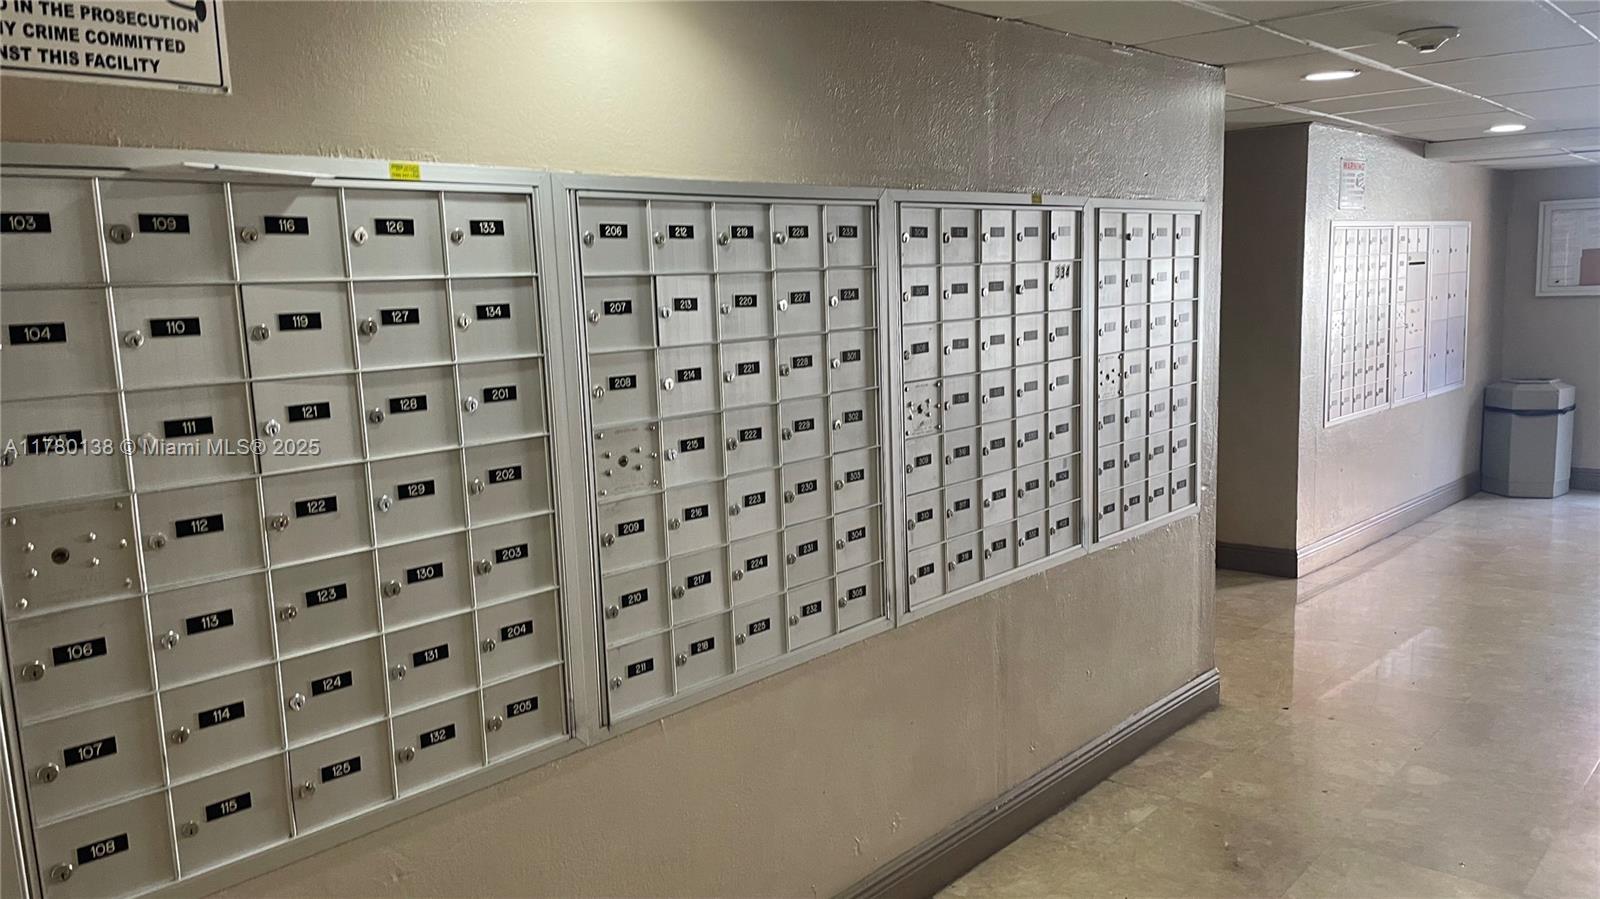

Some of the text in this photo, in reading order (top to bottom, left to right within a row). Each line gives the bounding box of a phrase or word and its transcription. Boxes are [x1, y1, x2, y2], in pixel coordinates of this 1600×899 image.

[14, 0, 34, 14] IN
[38, 1, 75, 19] THE
[80, 5, 199, 34] PROSECUTION
[23, 23, 80, 43] CRIME
[85, 30, 186, 54] COMMITTED
[37, 48, 80, 66] THIS
[84, 52, 160, 74] FACILITY
[9, 215, 36, 230] 103
[152, 217, 177, 231] 109
[279, 219, 295, 232] 116
[386, 221, 404, 233] 126
[479, 222, 496, 234] 133
[604, 225, 622, 236] 206
[674, 226, 688, 237] 212
[736, 227, 748, 237] 219
[791, 227, 805, 237] 226
[1055, 263, 1070, 279] 334
[738, 296, 753, 307] 220
[793, 293, 807, 303] 227
[843, 290, 856, 300] 234
[609, 302, 626, 313] 207
[680, 299, 692, 309] 213
[391, 310, 409, 323] 127
[485, 306, 502, 317] 134
[166, 320, 185, 334] 110
[292, 315, 309, 328] 119
[24, 326, 51, 341] 104
[796, 357, 809, 367] 228
[683, 370, 696, 381] 214
[743, 364, 755, 375] 221
[614, 377, 631, 388] 208
[492, 388, 509, 400] 201
[400, 398, 418, 410] 128
[302, 405, 318, 418] 121
[182, 421, 196, 434] 111
[797, 420, 811, 430] 229
[744, 430, 757, 440] 222
[686, 439, 699, 450] 215
[495, 468, 515, 481] 202
[408, 483, 425, 496] 129
[800, 482, 814, 493] 230
[748, 494, 761, 505] 223
[307, 500, 326, 513] 122
[690, 507, 703, 518] 216
[191, 519, 208, 533] 112
[623, 522, 640, 534] 209
[502, 547, 522, 560] 203
[803, 543, 814, 554] 231
[750, 558, 764, 569] 224
[416, 566, 434, 579] 130
[693, 574, 705, 586] 217
[317, 588, 337, 602] 123
[628, 592, 642, 605] 210
[806, 604, 818, 615] 232
[201, 614, 219, 629] 113
[753, 621, 766, 632] 225
[507, 624, 526, 638] 204
[67, 643, 93, 660] 106
[697, 641, 709, 653] 218
[424, 648, 438, 662] 131
[635, 662, 646, 674] 211
[323, 676, 341, 691] 124
[213, 707, 230, 722] 114
[513, 702, 532, 715] 205
[430, 729, 446, 743] 132
[78, 742, 102, 760] 107
[332, 762, 351, 777] 125
[220, 799, 238, 814] 115
[91, 840, 115, 858] 108
